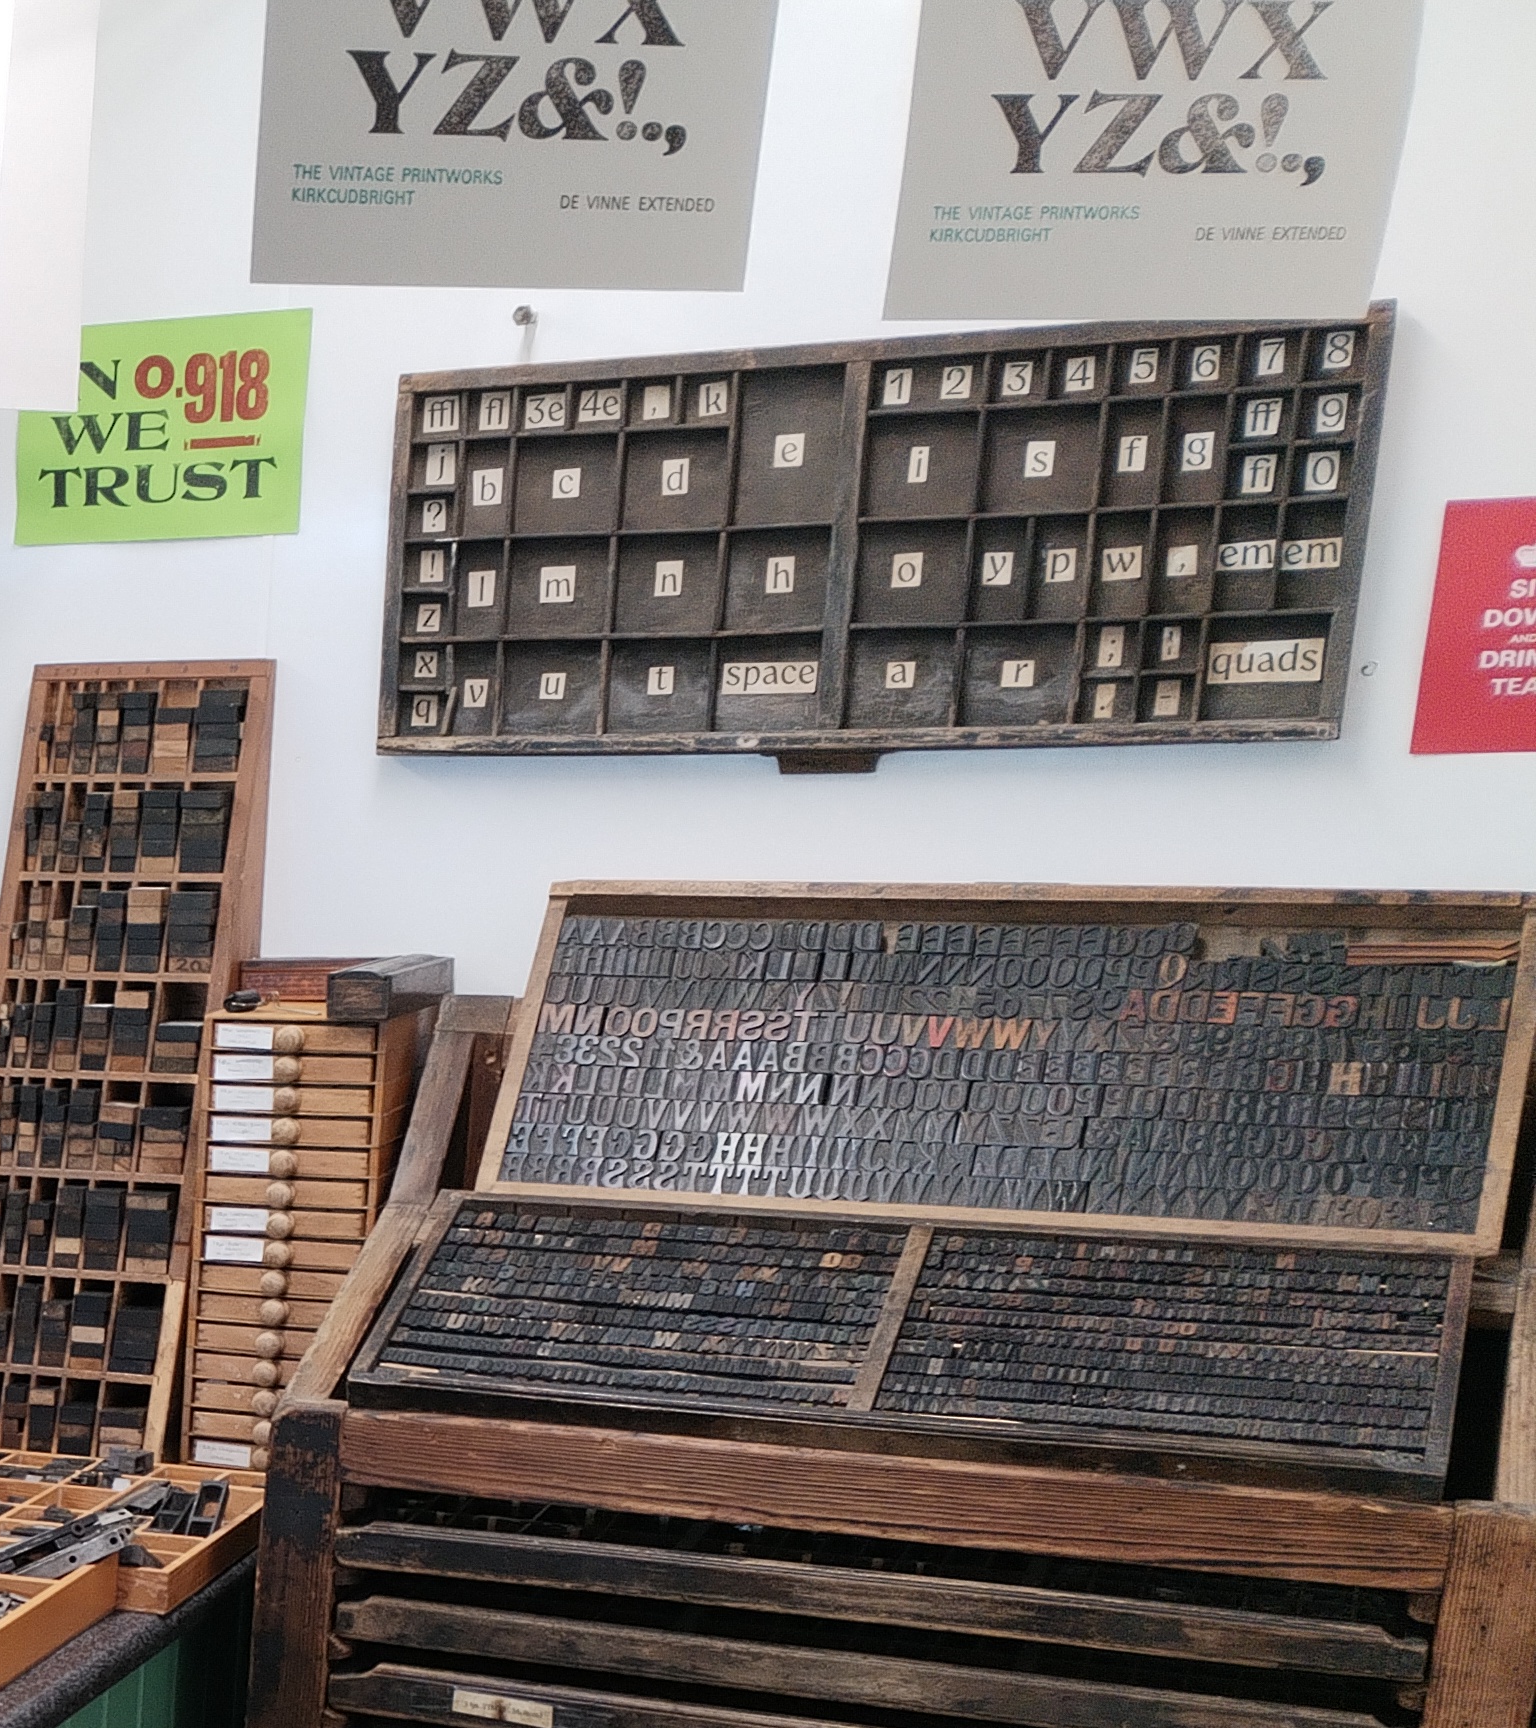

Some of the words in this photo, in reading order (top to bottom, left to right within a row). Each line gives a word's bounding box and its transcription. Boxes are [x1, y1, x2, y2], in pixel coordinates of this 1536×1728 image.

[1016, 0, 1329, 81] VWX
[293, 163, 321, 181] THE
[329, 165, 395, 184] VINTAGE
[401, 166, 504, 186] PRINTWORKS
[291, 187, 416, 207] KIRKCUDBRIGHT
[559, 194, 579, 210] DE
[587, 194, 630, 212] VINNE
[638, 196, 715, 214] EXTENDED
[933, 206, 961, 221] THE
[968, 206, 1033, 222] VINTAGE
[1040, 206, 1140, 222] PRINTWORKS
[929, 227, 1051, 244] KIRKCUDBRIGHT
[1195, 226, 1215, 242] DE
[1221, 226, 1266, 242] VINNE
[1272, 226, 1346, 243] EXTENDED
[947, 369, 965, 395] 2
[1008, 365, 1027, 393] 3
[1068, 359, 1092, 387] 4
[1136, 352, 1157, 380] 5
[1196, 348, 1216, 379] 6
[1265, 341, 1286, 370] 7
[1329, 334, 1352, 366] 8
[50, 410, 170, 455] WE
[39, 456, 277, 508] TRUST
[1220, 543, 1272, 567] em
[1285, 542, 1338, 566] em
[725, 661, 816, 692] space
[1212, 644, 1319, 679] quads
